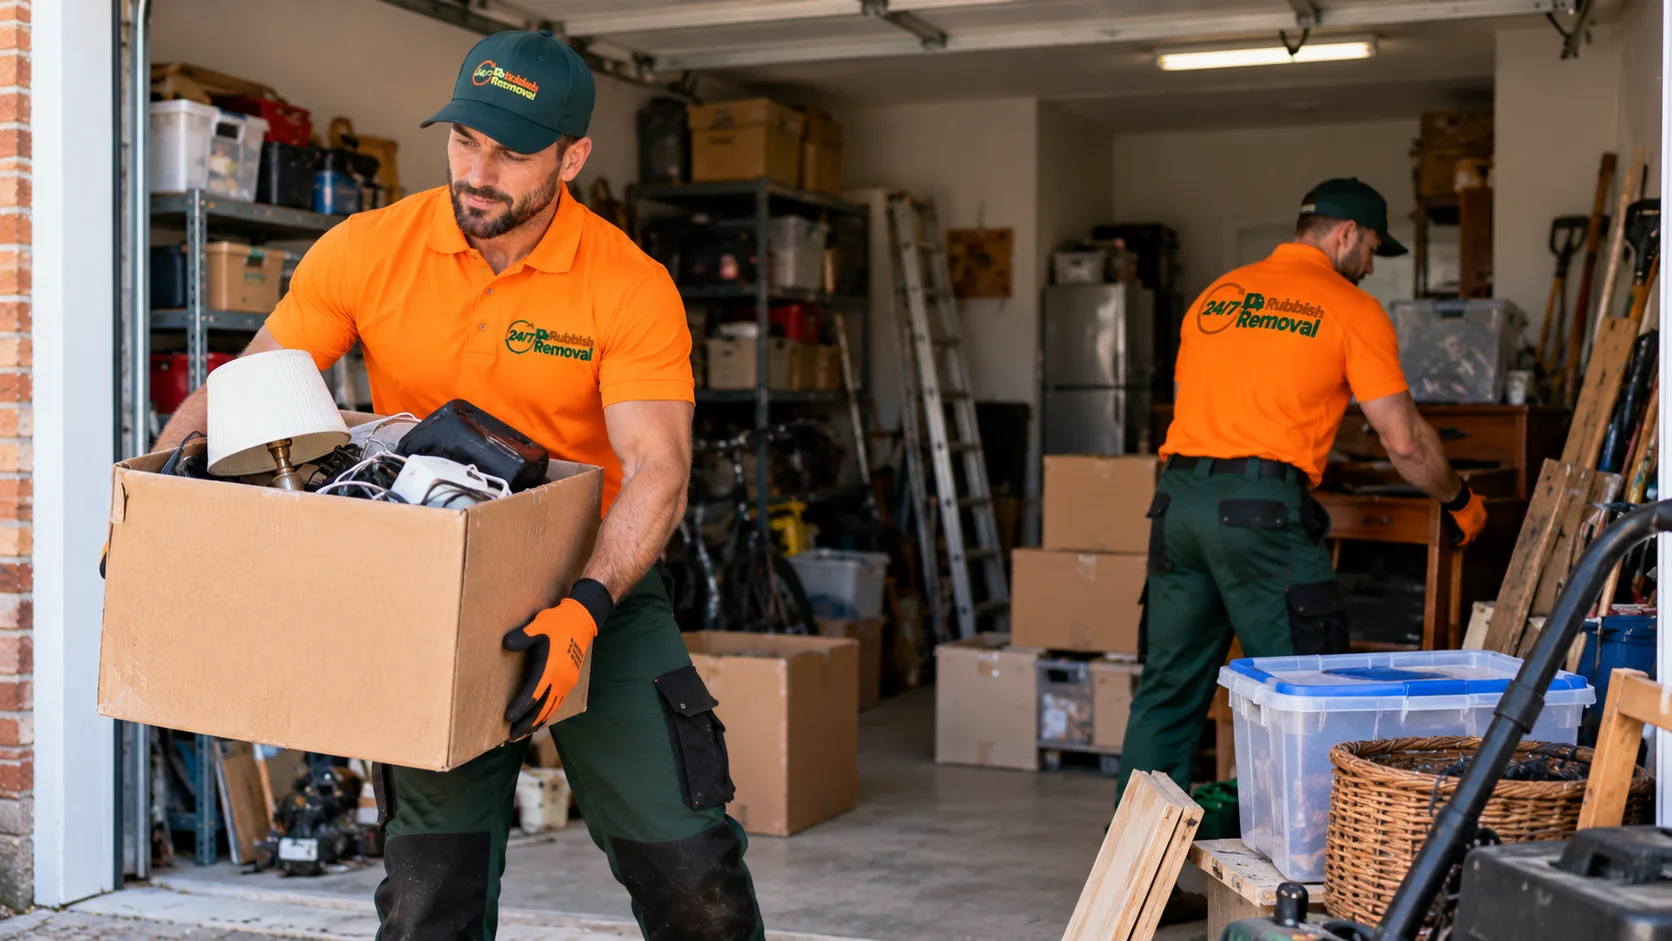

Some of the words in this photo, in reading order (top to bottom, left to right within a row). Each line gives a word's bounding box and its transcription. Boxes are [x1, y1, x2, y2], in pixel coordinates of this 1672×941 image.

[1202, 300, 1242, 316] 24/7
[1265, 297, 1325, 319] Rubbish
[1236, 310, 1321, 338] Removal
[508, 329, 535, 343] 24/7
[549, 330, 595, 347] Rubbish
[534, 341, 593, 361] Removal
